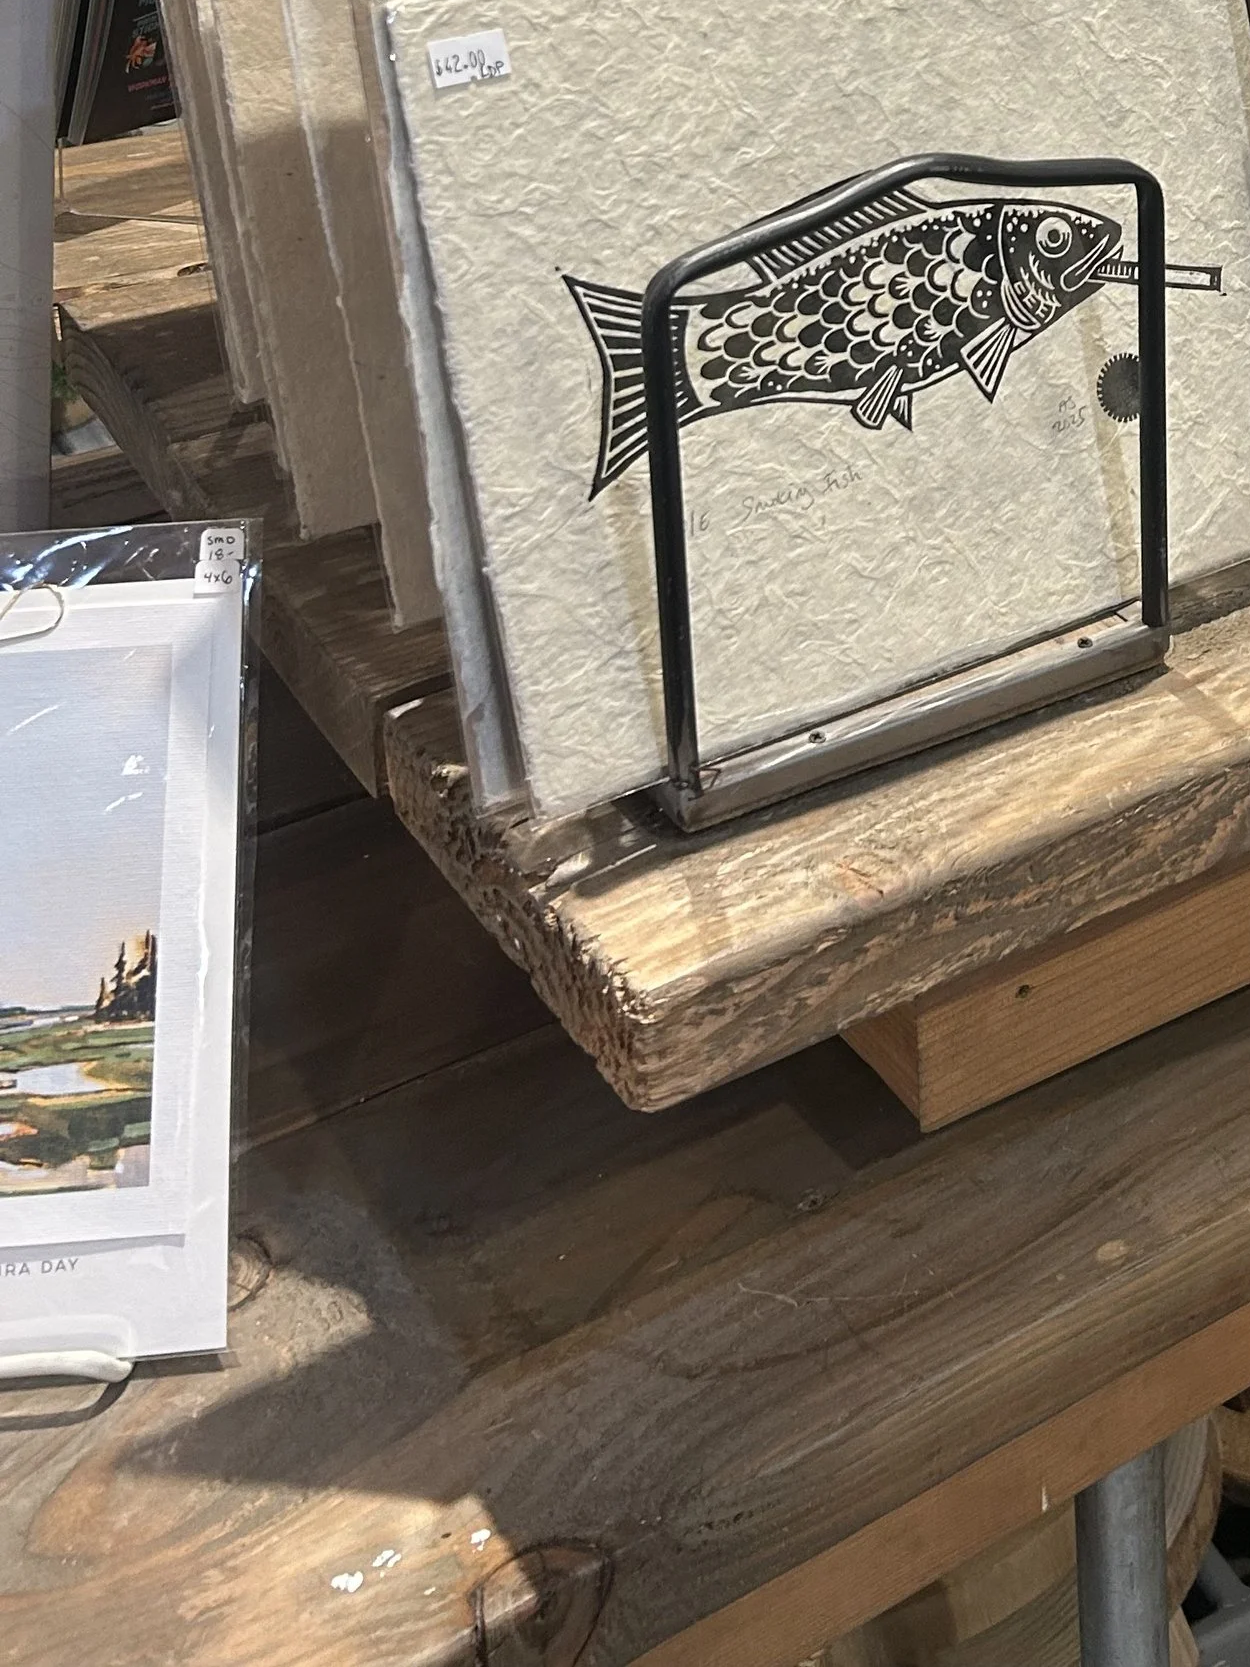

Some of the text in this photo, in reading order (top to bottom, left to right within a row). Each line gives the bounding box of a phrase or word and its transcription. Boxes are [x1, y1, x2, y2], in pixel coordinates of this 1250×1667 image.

[820, 465, 862, 495] Fish
[209, 548, 234, 560] 18-
[204, 570, 233, 584] 4x6
[41, 1258, 79, 1274] DAY
